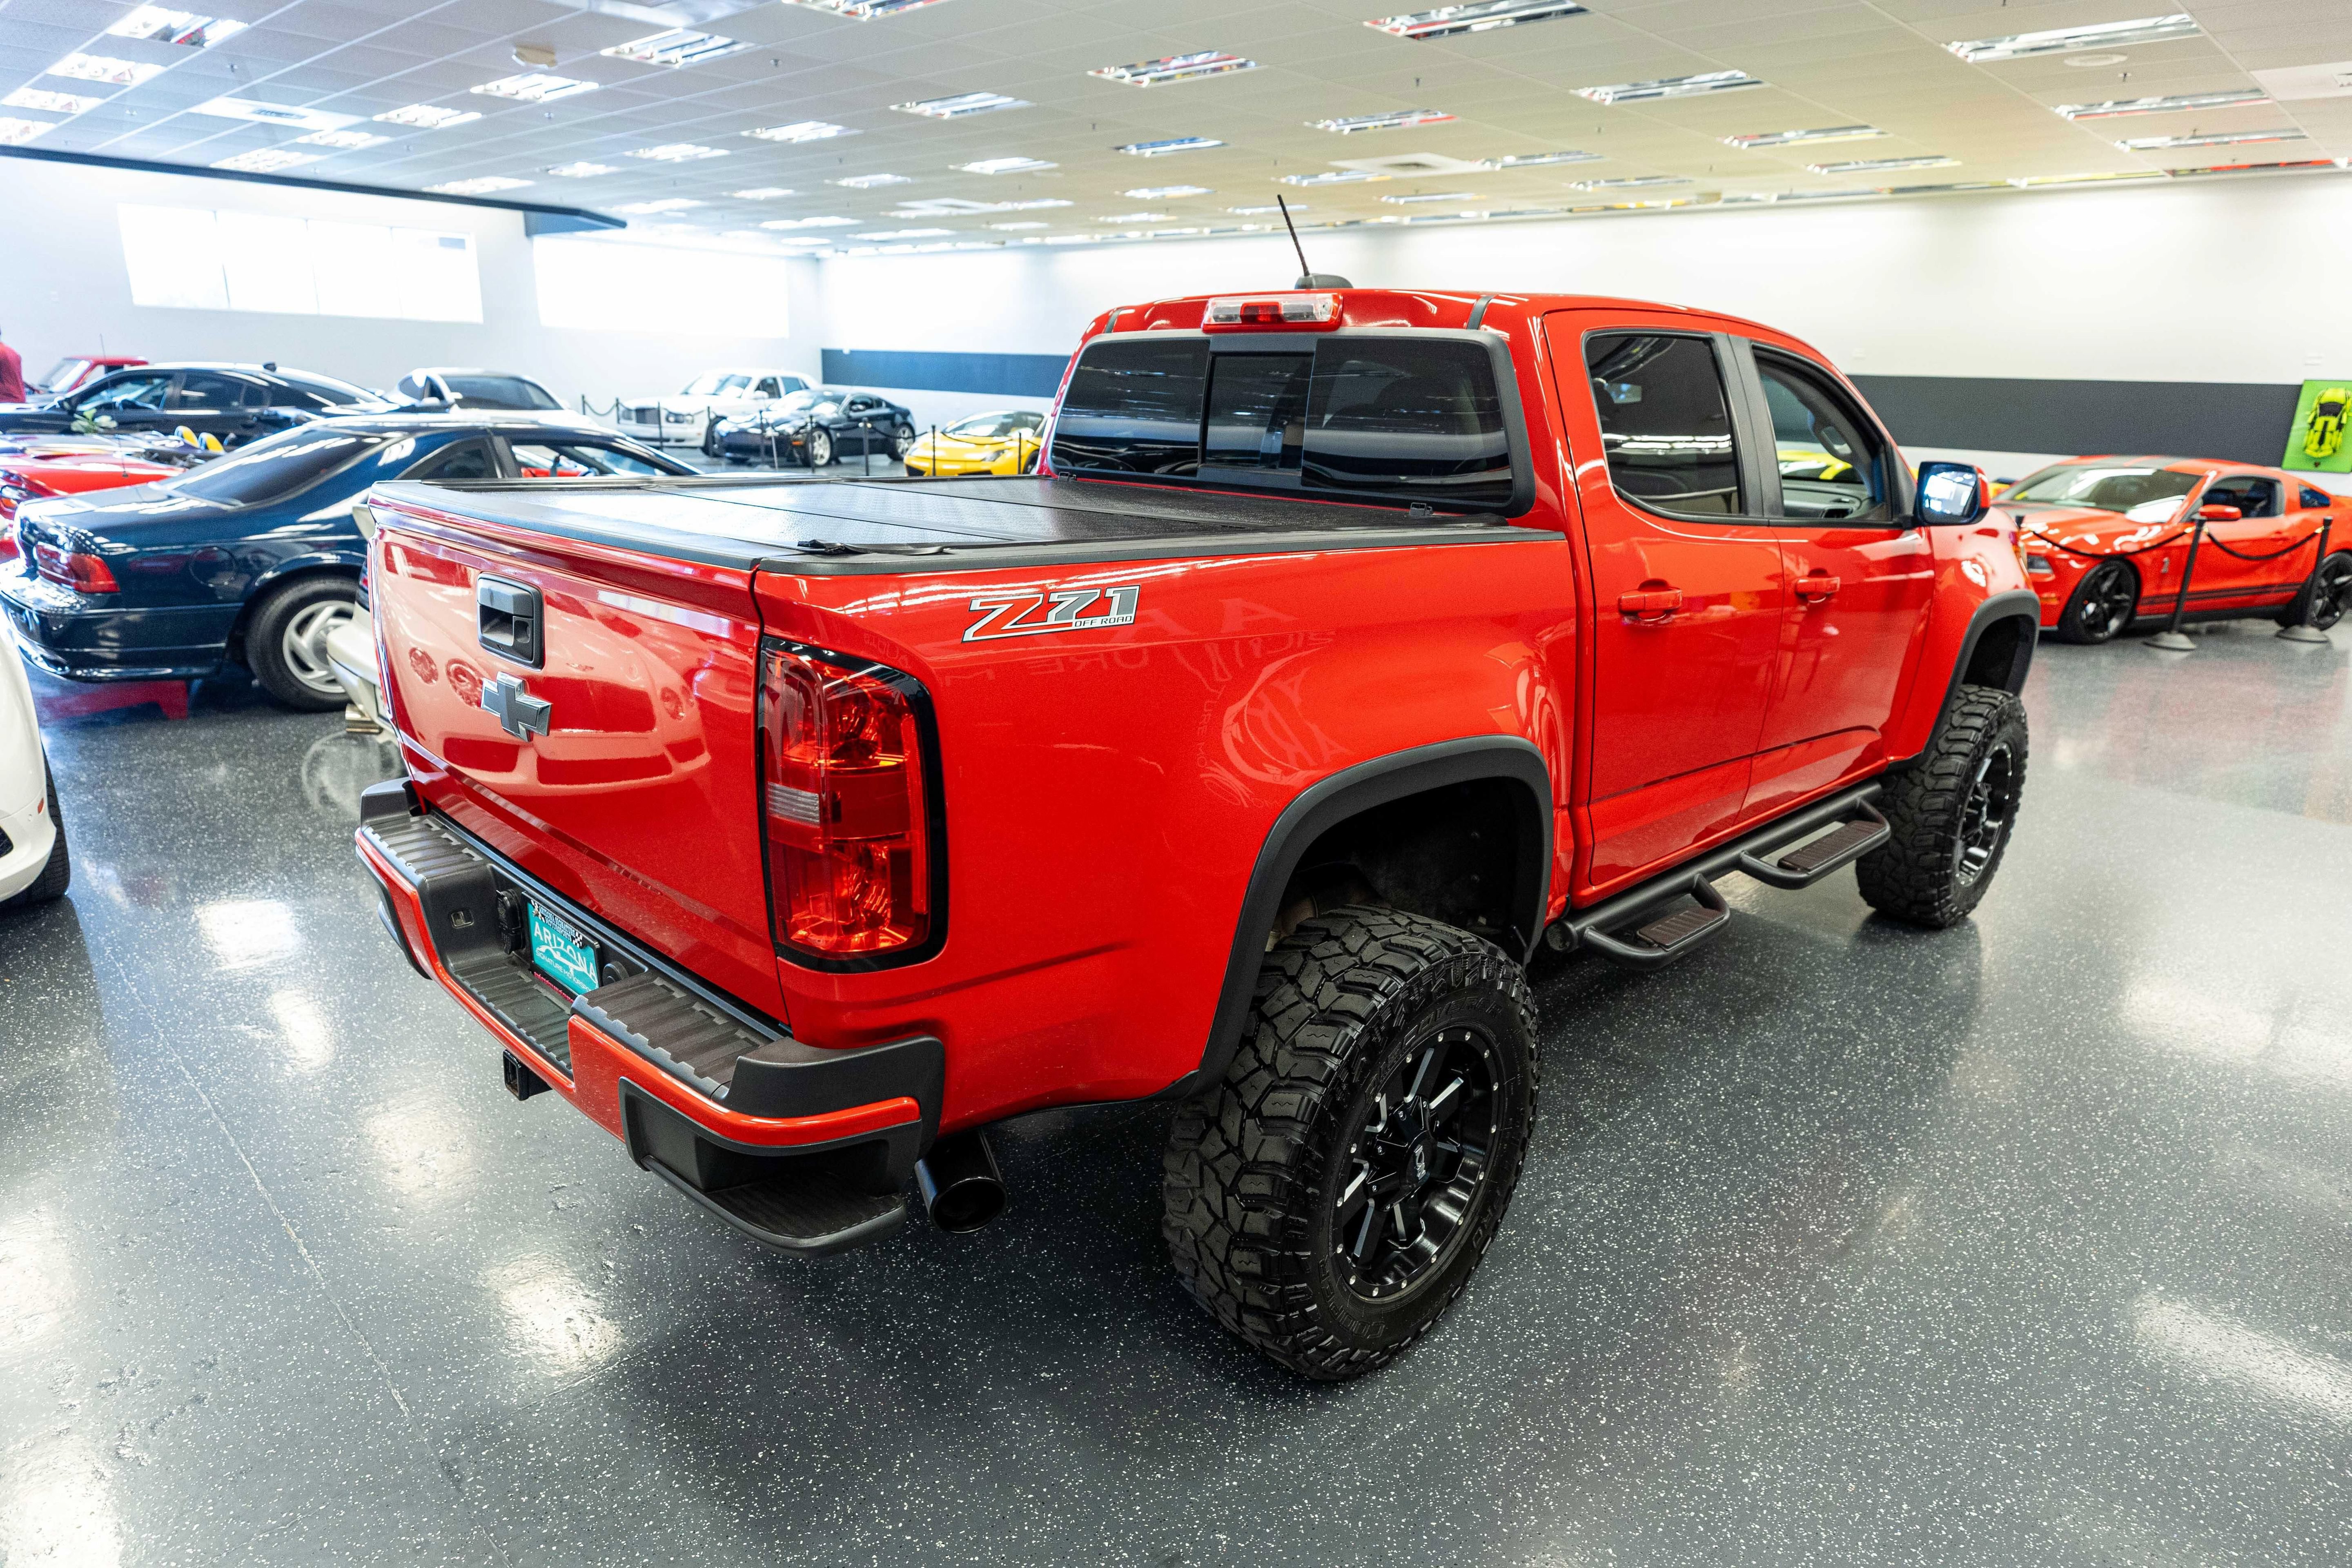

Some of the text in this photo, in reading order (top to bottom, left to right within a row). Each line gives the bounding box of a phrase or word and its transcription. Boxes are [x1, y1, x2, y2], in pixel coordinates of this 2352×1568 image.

[961, 585, 1140, 643] Z71
[1074, 615, 1132, 628] OFF ROAD
[534, 921, 597, 982] ARIZONA
[535, 949, 563, 973] SIGNATURE
